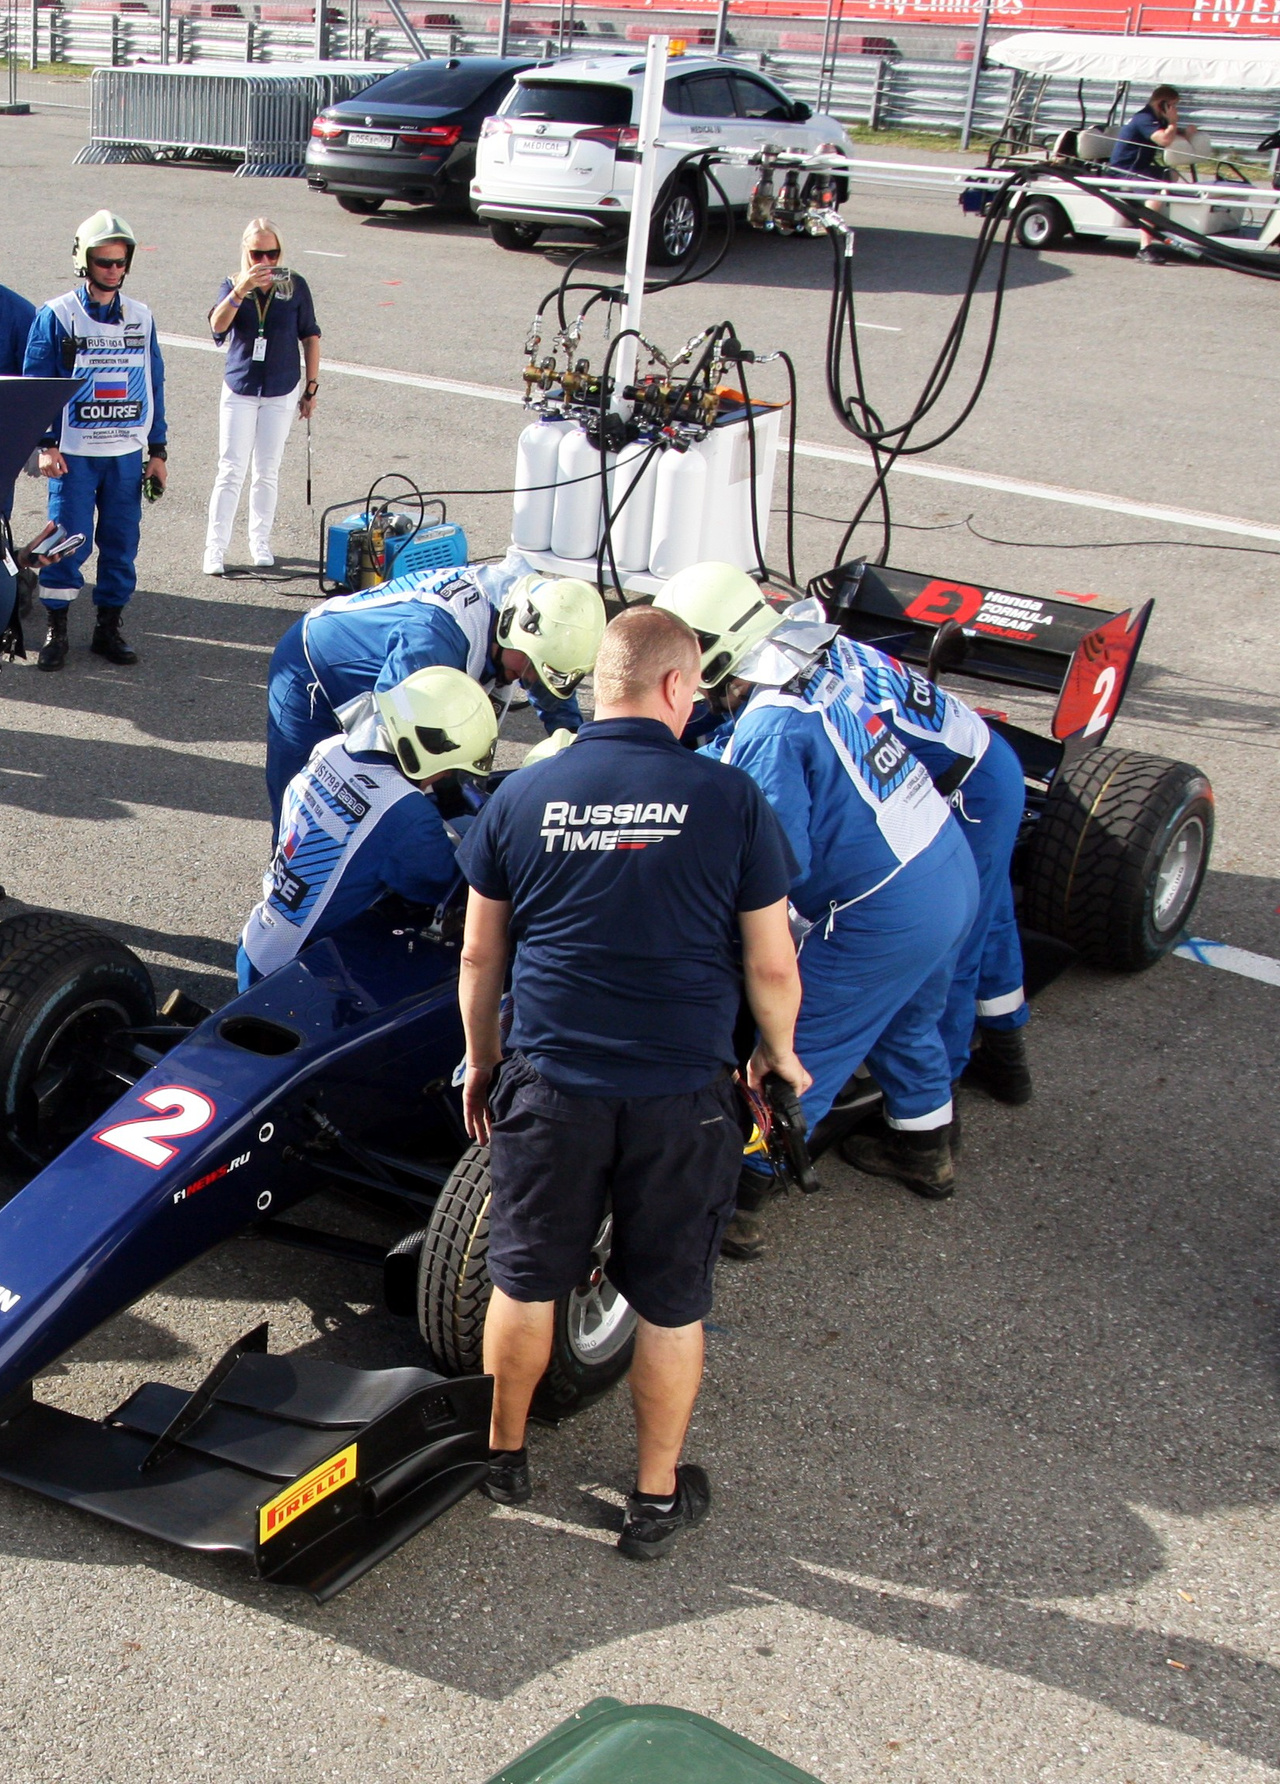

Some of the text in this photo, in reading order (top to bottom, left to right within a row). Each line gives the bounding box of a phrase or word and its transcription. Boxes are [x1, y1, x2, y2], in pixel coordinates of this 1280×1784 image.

[523, 141, 560, 151] MEDICAL
[80, 405, 138, 419] COURSE
[984, 591, 1043, 611] Honda
[976, 613, 1034, 632] DREAM
[980, 602, 1054, 626] FORMULA
[972, 622, 1039, 642] PROJECT
[1082, 666, 1116, 738] 2
[337, 791, 366, 816] 2018
[541, 801, 689, 827] RUSSIAN
[540, 828, 619, 853] TIME
[91, 1084, 217, 1171] 2
[267, 1457, 348, 1532] PIRELLI
